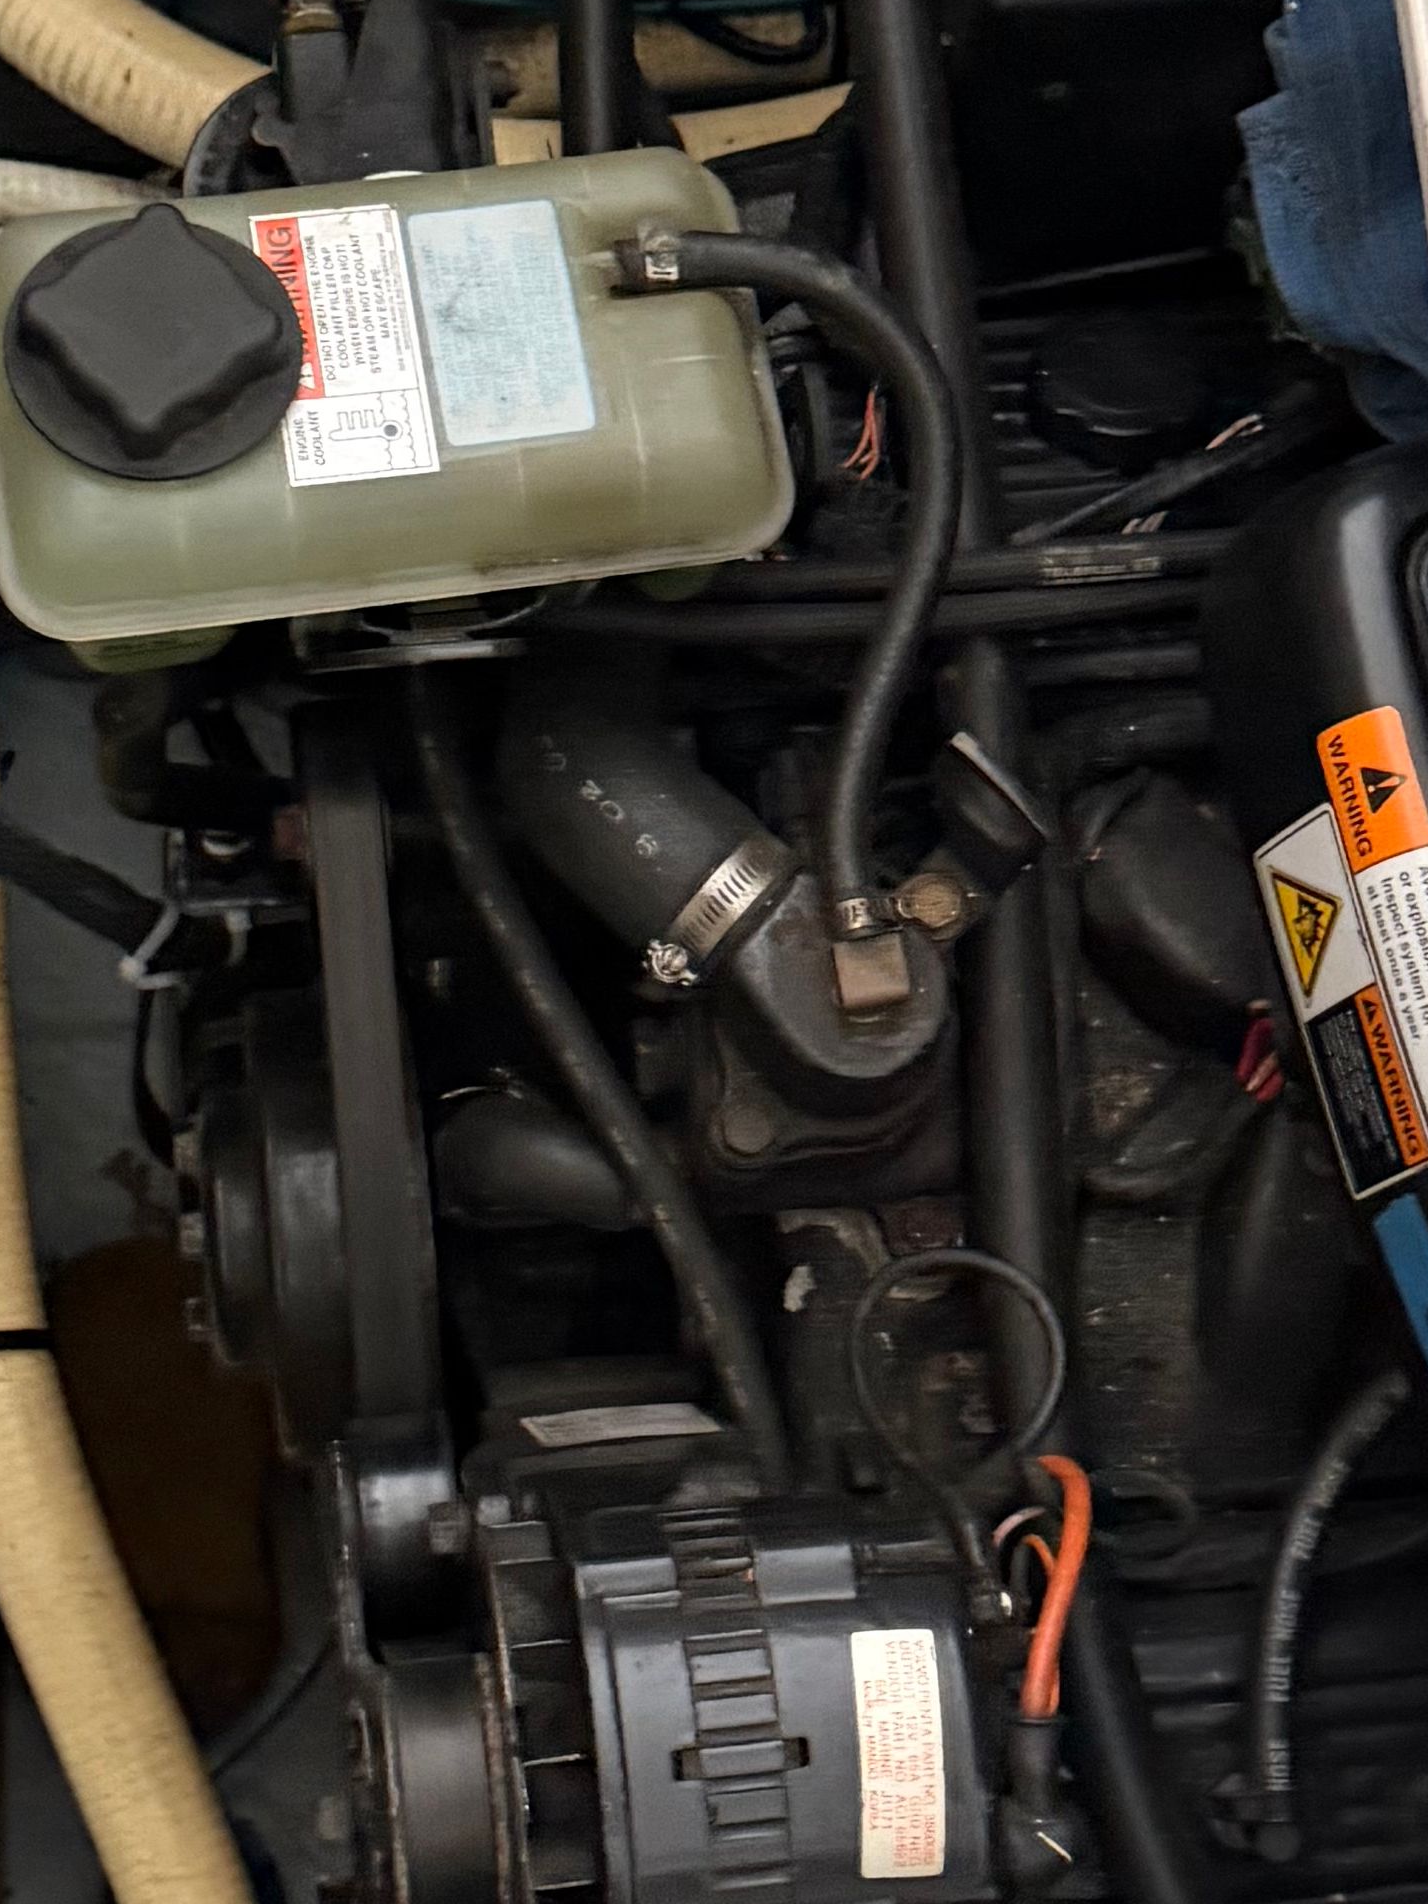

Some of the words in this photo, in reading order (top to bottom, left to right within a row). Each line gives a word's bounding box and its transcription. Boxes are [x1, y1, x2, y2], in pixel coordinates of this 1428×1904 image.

[302, 234, 319, 276] ENGINE
[320, 246, 333, 270] CAP
[348, 232, 367, 287] COOLANT
[310, 279, 323, 300] THE
[324, 272, 340, 311] FILLER
[339, 273, 351, 284] IS
[314, 303, 329, 335] OPEN
[342, 287, 359, 329] ENGINE
[358, 289, 371, 312] HOT
[331, 314, 350, 368] COOLANT
[362, 315, 374, 332] OR
[377, 314, 391, 338] MAY
[320, 339, 333, 361] NOT
[350, 331, 365, 365] WHEN
[365, 335, 381, 373] STEAM
[324, 364, 336, 381] DO
[291, 417, 309, 461] ENGINE
[306, 408, 326, 466] COOLANT
[1327, 735, 1373, 858] WARNING
[1365, 884, 1378, 901] at
[1398, 870, 1413, 888] or
[1371, 903, 1392, 943] least
[1377, 876, 1409, 938] Inspect
[1397, 940, 1428, 1001] system
[1384, 946, 1405, 990] once
[1398, 991, 1408, 1001] a
[1371, 1023, 1420, 1158] WARNING
[885, 1641, 902, 1703] VENDOR
[899, 1640, 914, 1698] OUTPUT
[913, 1640, 929, 1685] VOLVO
[891, 1711, 905, 1750] PART
[918, 1690, 932, 1736] PENTA
[877, 1721, 892, 1778] MARINE
[922, 1742, 935, 1776] PART
